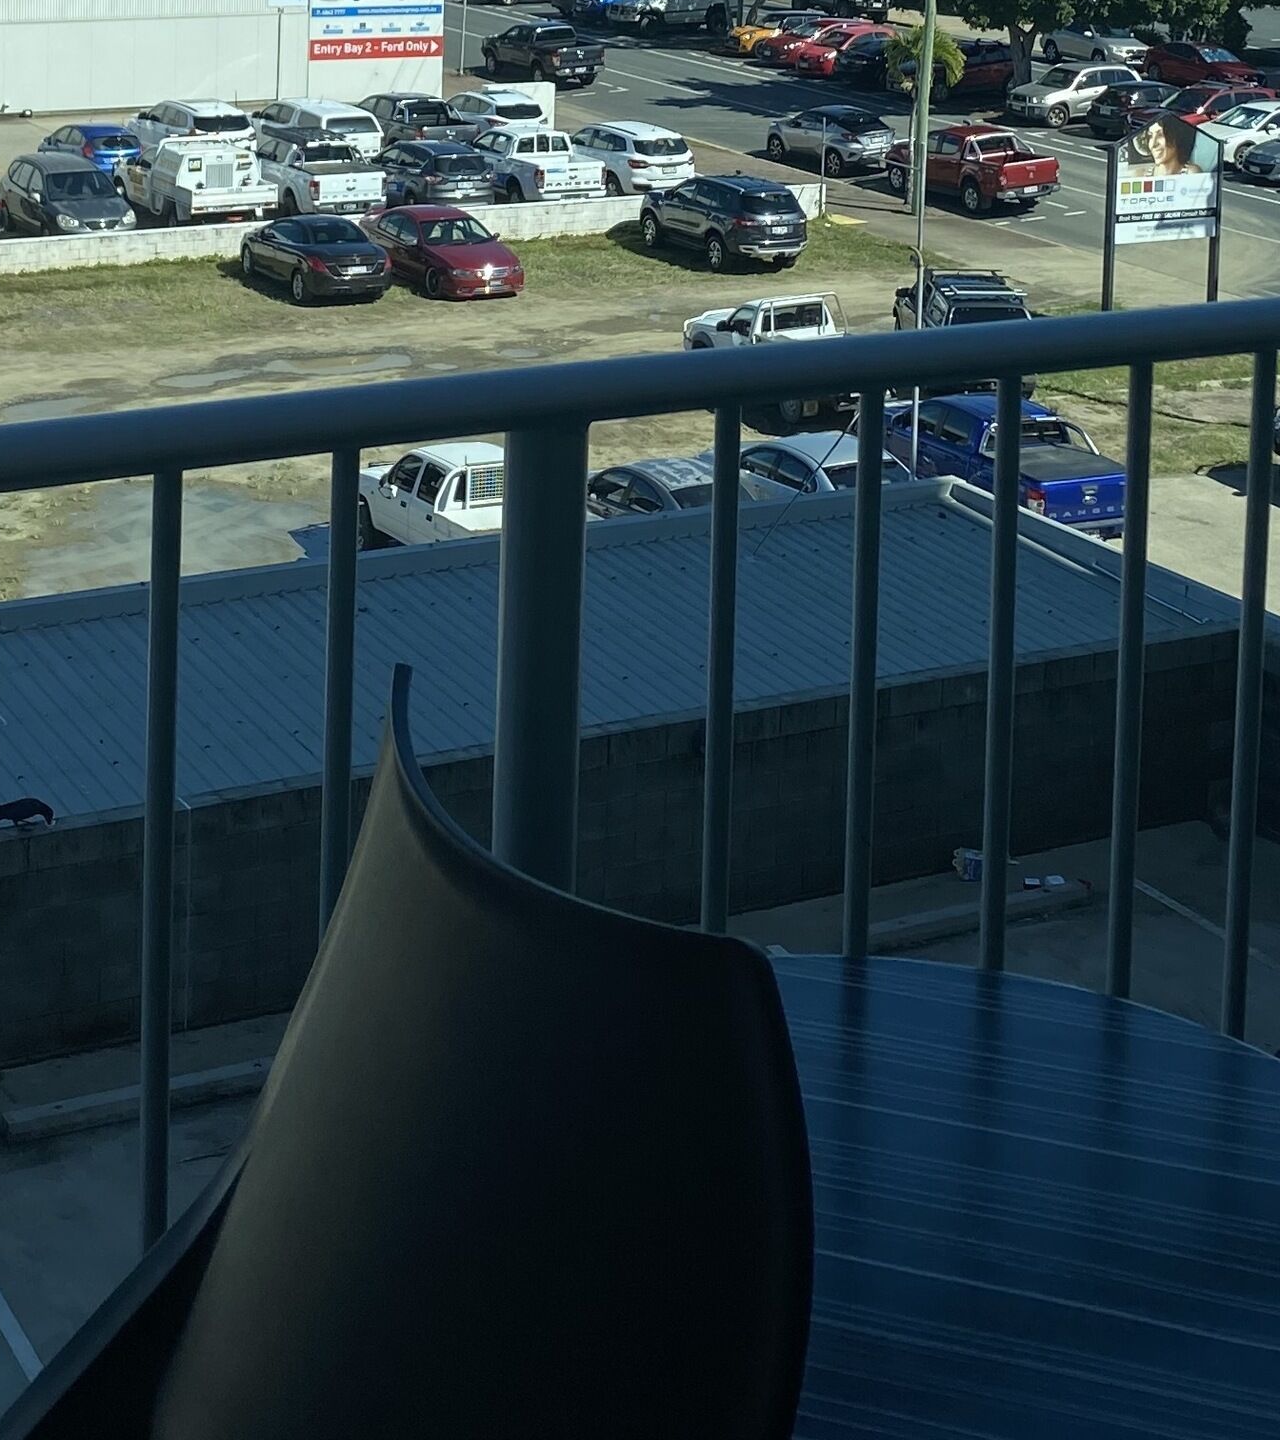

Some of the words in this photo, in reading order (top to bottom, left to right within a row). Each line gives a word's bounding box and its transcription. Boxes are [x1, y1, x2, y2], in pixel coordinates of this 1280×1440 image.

[314, 43, 342, 56] Entry
[344, 43, 363, 55] Bay
[365, 42, 372, 52] 2
[381, 41, 404, 52] Ford
[406, 40, 429, 53] Only
[1120, 195, 1175, 205] TORQUE
